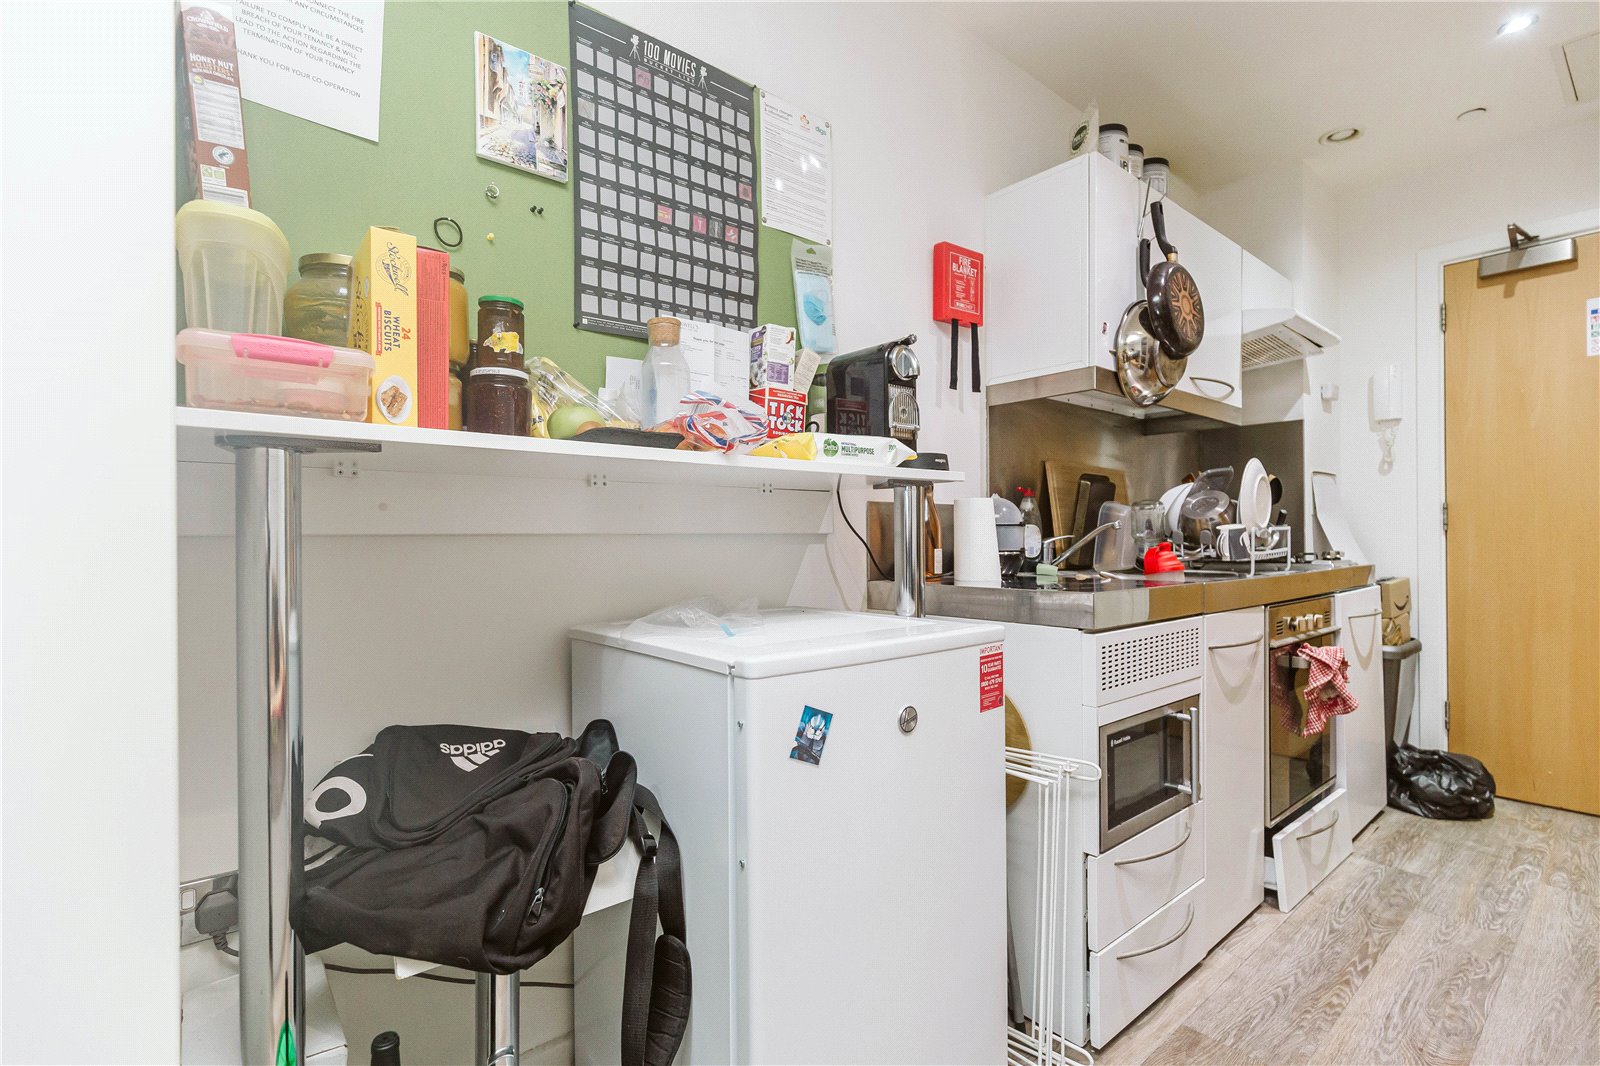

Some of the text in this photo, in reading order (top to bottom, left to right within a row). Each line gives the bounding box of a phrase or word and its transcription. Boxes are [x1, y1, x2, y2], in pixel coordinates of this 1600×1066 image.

[235, 0, 265, 13] AILURE
[267, 10, 277, 18] TO
[278, 15, 307, 30] COMPLY
[308, 26, 324, 38] WILL
[326, 33, 334, 42] BE
[341, 40, 363, 53] DIRECT
[294, 0, 364, 34] ANY CIRCUMSTANCES
[338, 9, 350, 18] THE
[351, 15, 364, 26] FIRE
[235, 15, 362, 70] LEAD TO THE ACTION REGARDING THE
[241, 8, 271, 25] BREACH
[271, 20, 281, 29] OF
[283, 24, 303, 37] YOUR
[304, 33, 335, 50] TENANCY
[341, 49, 358, 61] WILL
[242, 27, 355, 75] TERMINATION OF YOUR TENANCY
[643, 40, 697, 78] 100 MOVIES
[190, 52, 234, 72] HONEY NUT
[237, 47, 361, 98] HANK YOU FOR YOUR CO-OPERATION
[952, 262, 977, 278] BLANKET
[959, 256, 971, 267] FIRE
[383, 309, 392, 352] BISCUITS
[392, 316, 401, 349] WHEAT
[401, 326, 411, 340] 24
[769, 401, 804, 420] TICK
[768, 415, 803, 433] TOCK
[841, 446, 875, 456] MULTIPURPOSE
[980, 643, 1004, 656] IMPORTANT
[981, 663, 988, 674] 10
[440, 739, 506, 757] adidas
